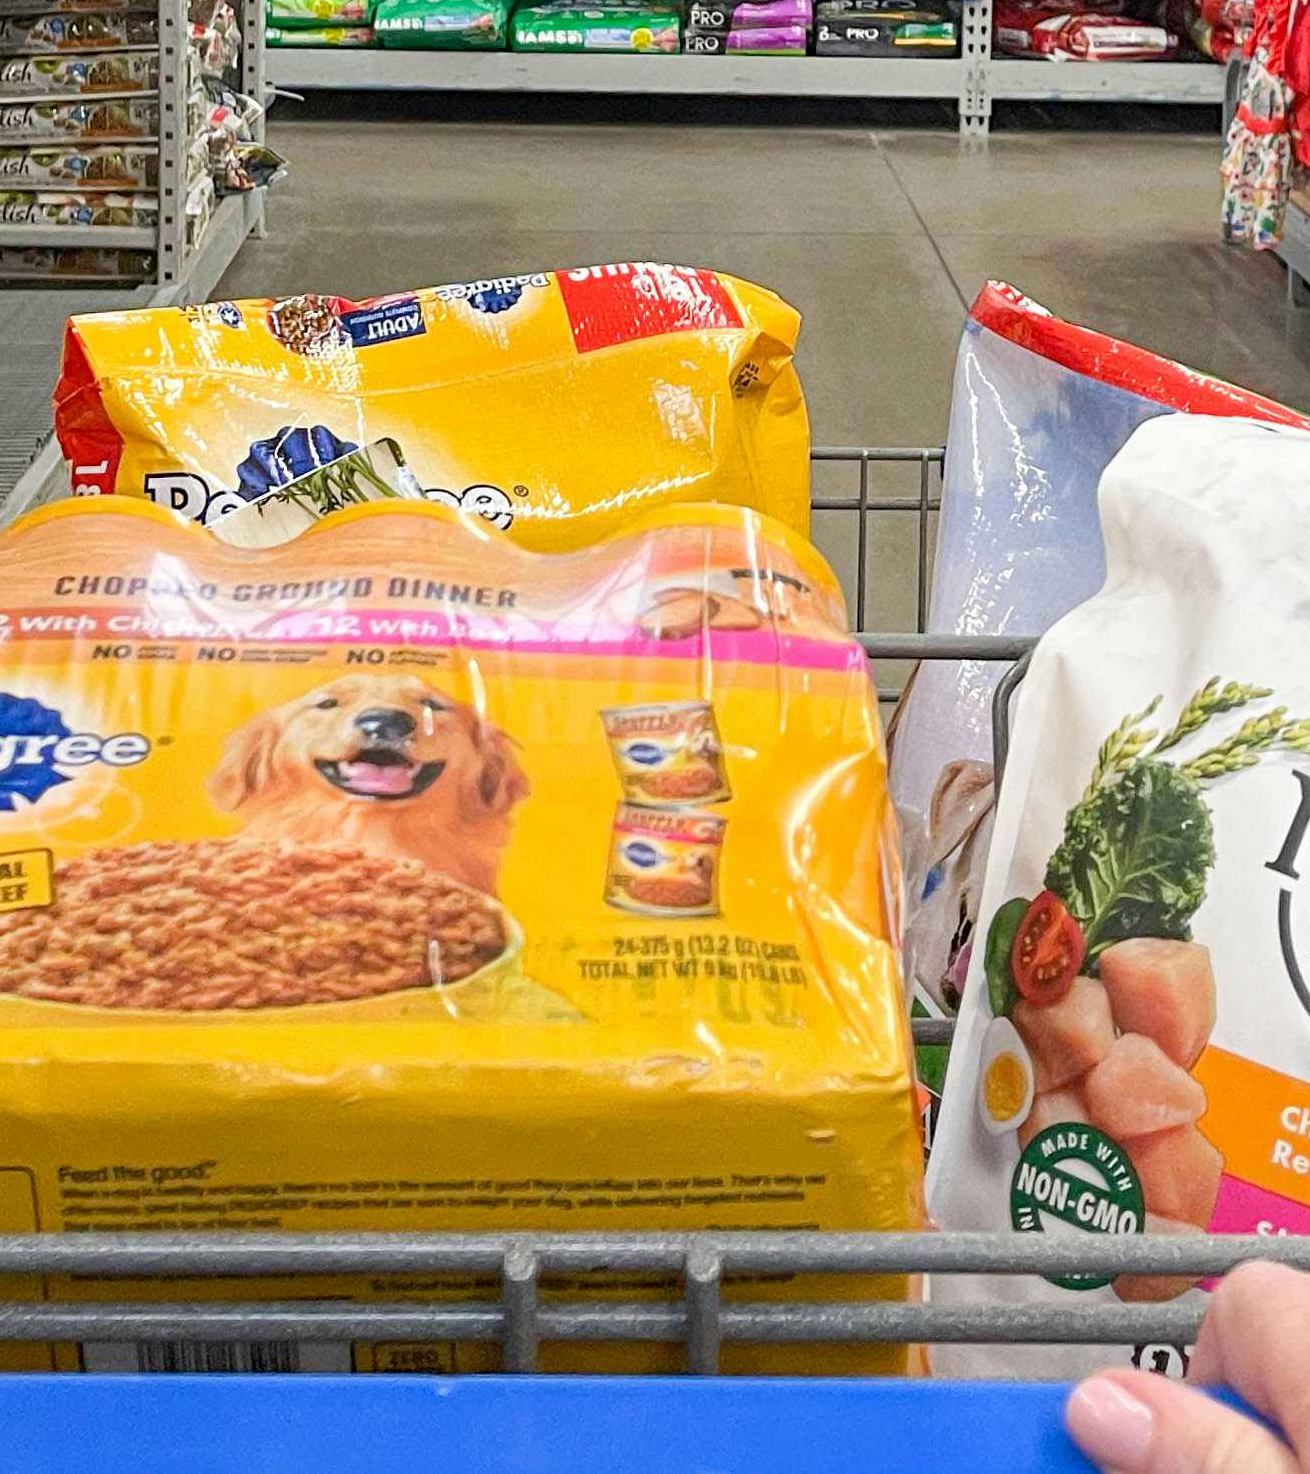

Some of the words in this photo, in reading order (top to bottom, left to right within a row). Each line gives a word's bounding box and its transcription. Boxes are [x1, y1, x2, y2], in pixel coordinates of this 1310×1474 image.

[691, 10, 724, 26] PRO
[517, 31, 567, 46] IAMS
[685, 36, 719, 52] PRO
[845, 26, 880, 42] PRO
[368, 312, 420, 339] ADULT
[231, 574, 374, 604] GROUND
[386, 575, 518, 608] DINNER
[19, 614, 96, 634] With
[315, 613, 361, 637] 12
[369, 617, 438, 639] With
[92, 644, 133, 661] NO
[196, 645, 237, 662] NO
[345, 648, 386, 667] NO
[577, 958, 633, 982] TOTAL
[671, 957, 701, 979] WT
[57, 1164, 109, 1183] Feed
[111, 1164, 147, 1183] the
[1039, 1131, 1091, 1159] MADE
[1093, 1142, 1134, 1194] WITH
[1016, 1162, 1138, 1236] NON-GMO
